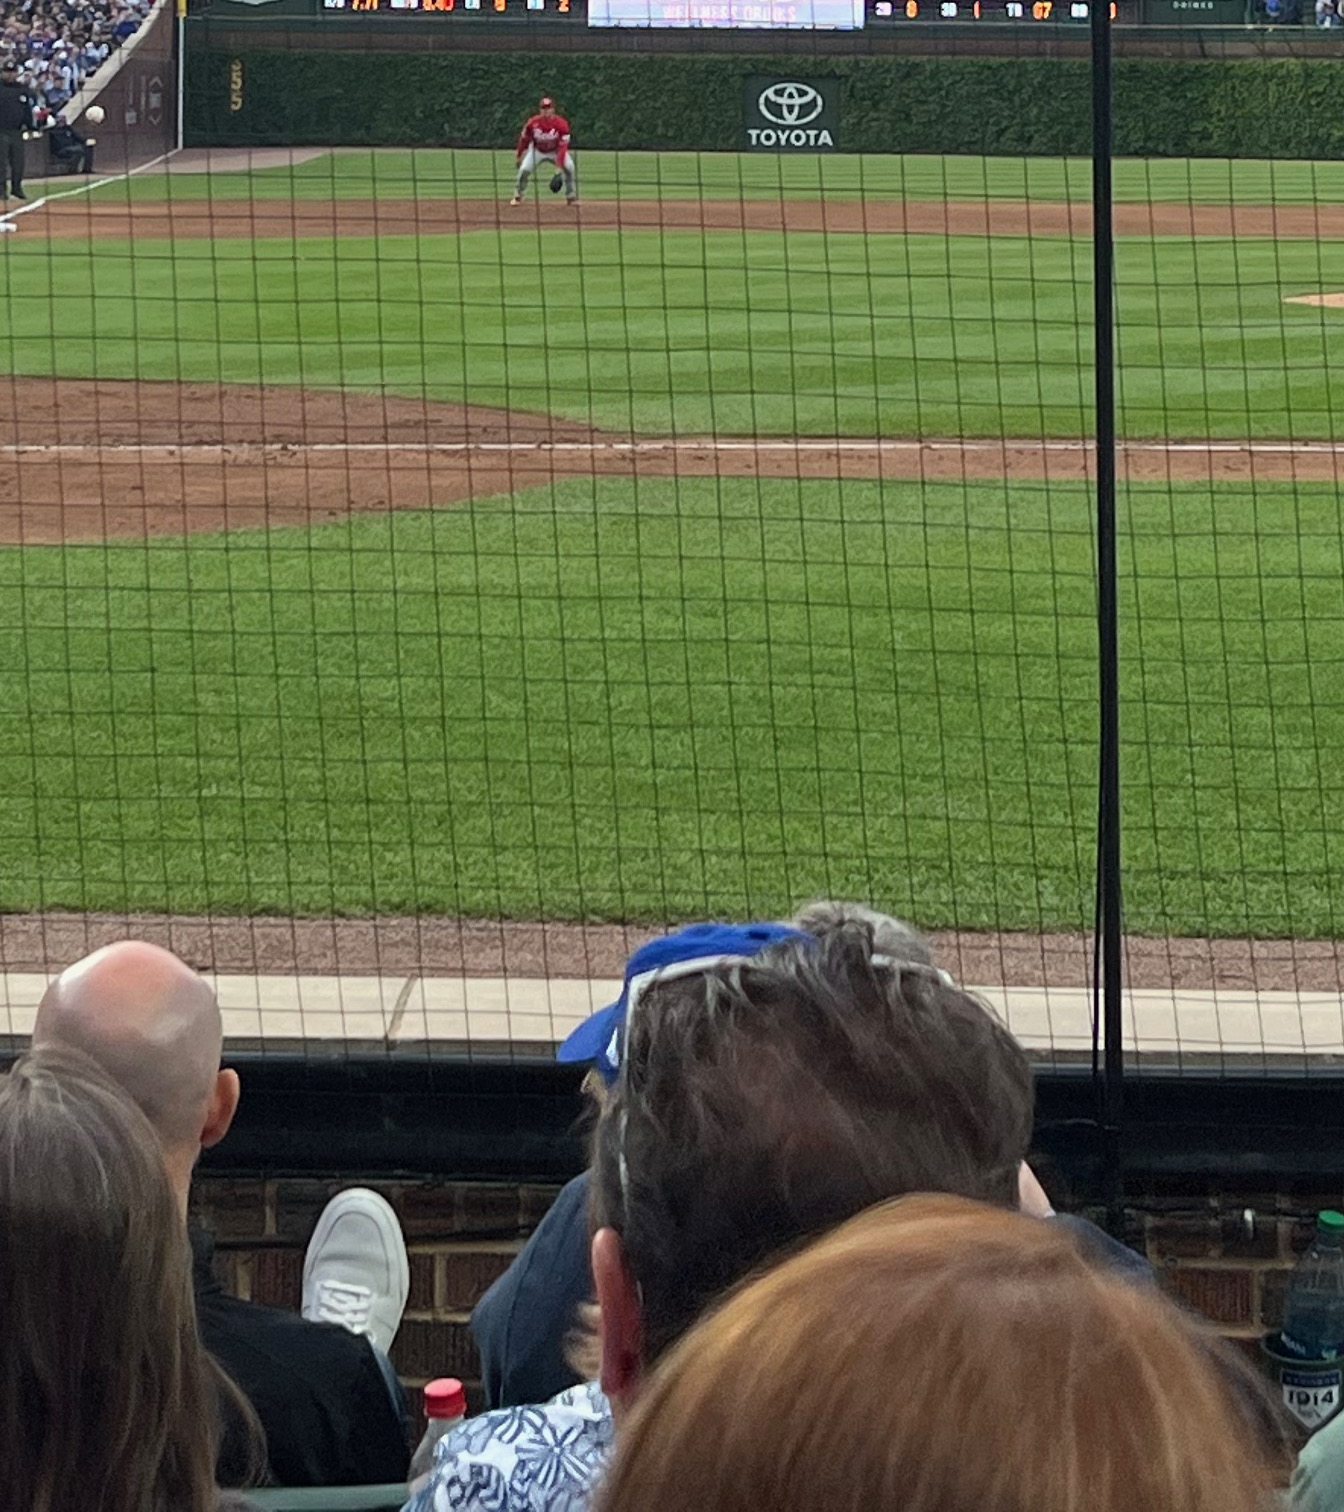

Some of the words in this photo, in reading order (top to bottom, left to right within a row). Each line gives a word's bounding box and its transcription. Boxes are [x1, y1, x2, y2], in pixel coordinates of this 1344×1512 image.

[662, 5, 739, 22] WELLNESS
[742, 6, 798, 24] DRINKS
[747, 129, 834, 147] TOYOTA
[1288, 1387, 1335, 1407] 1914
